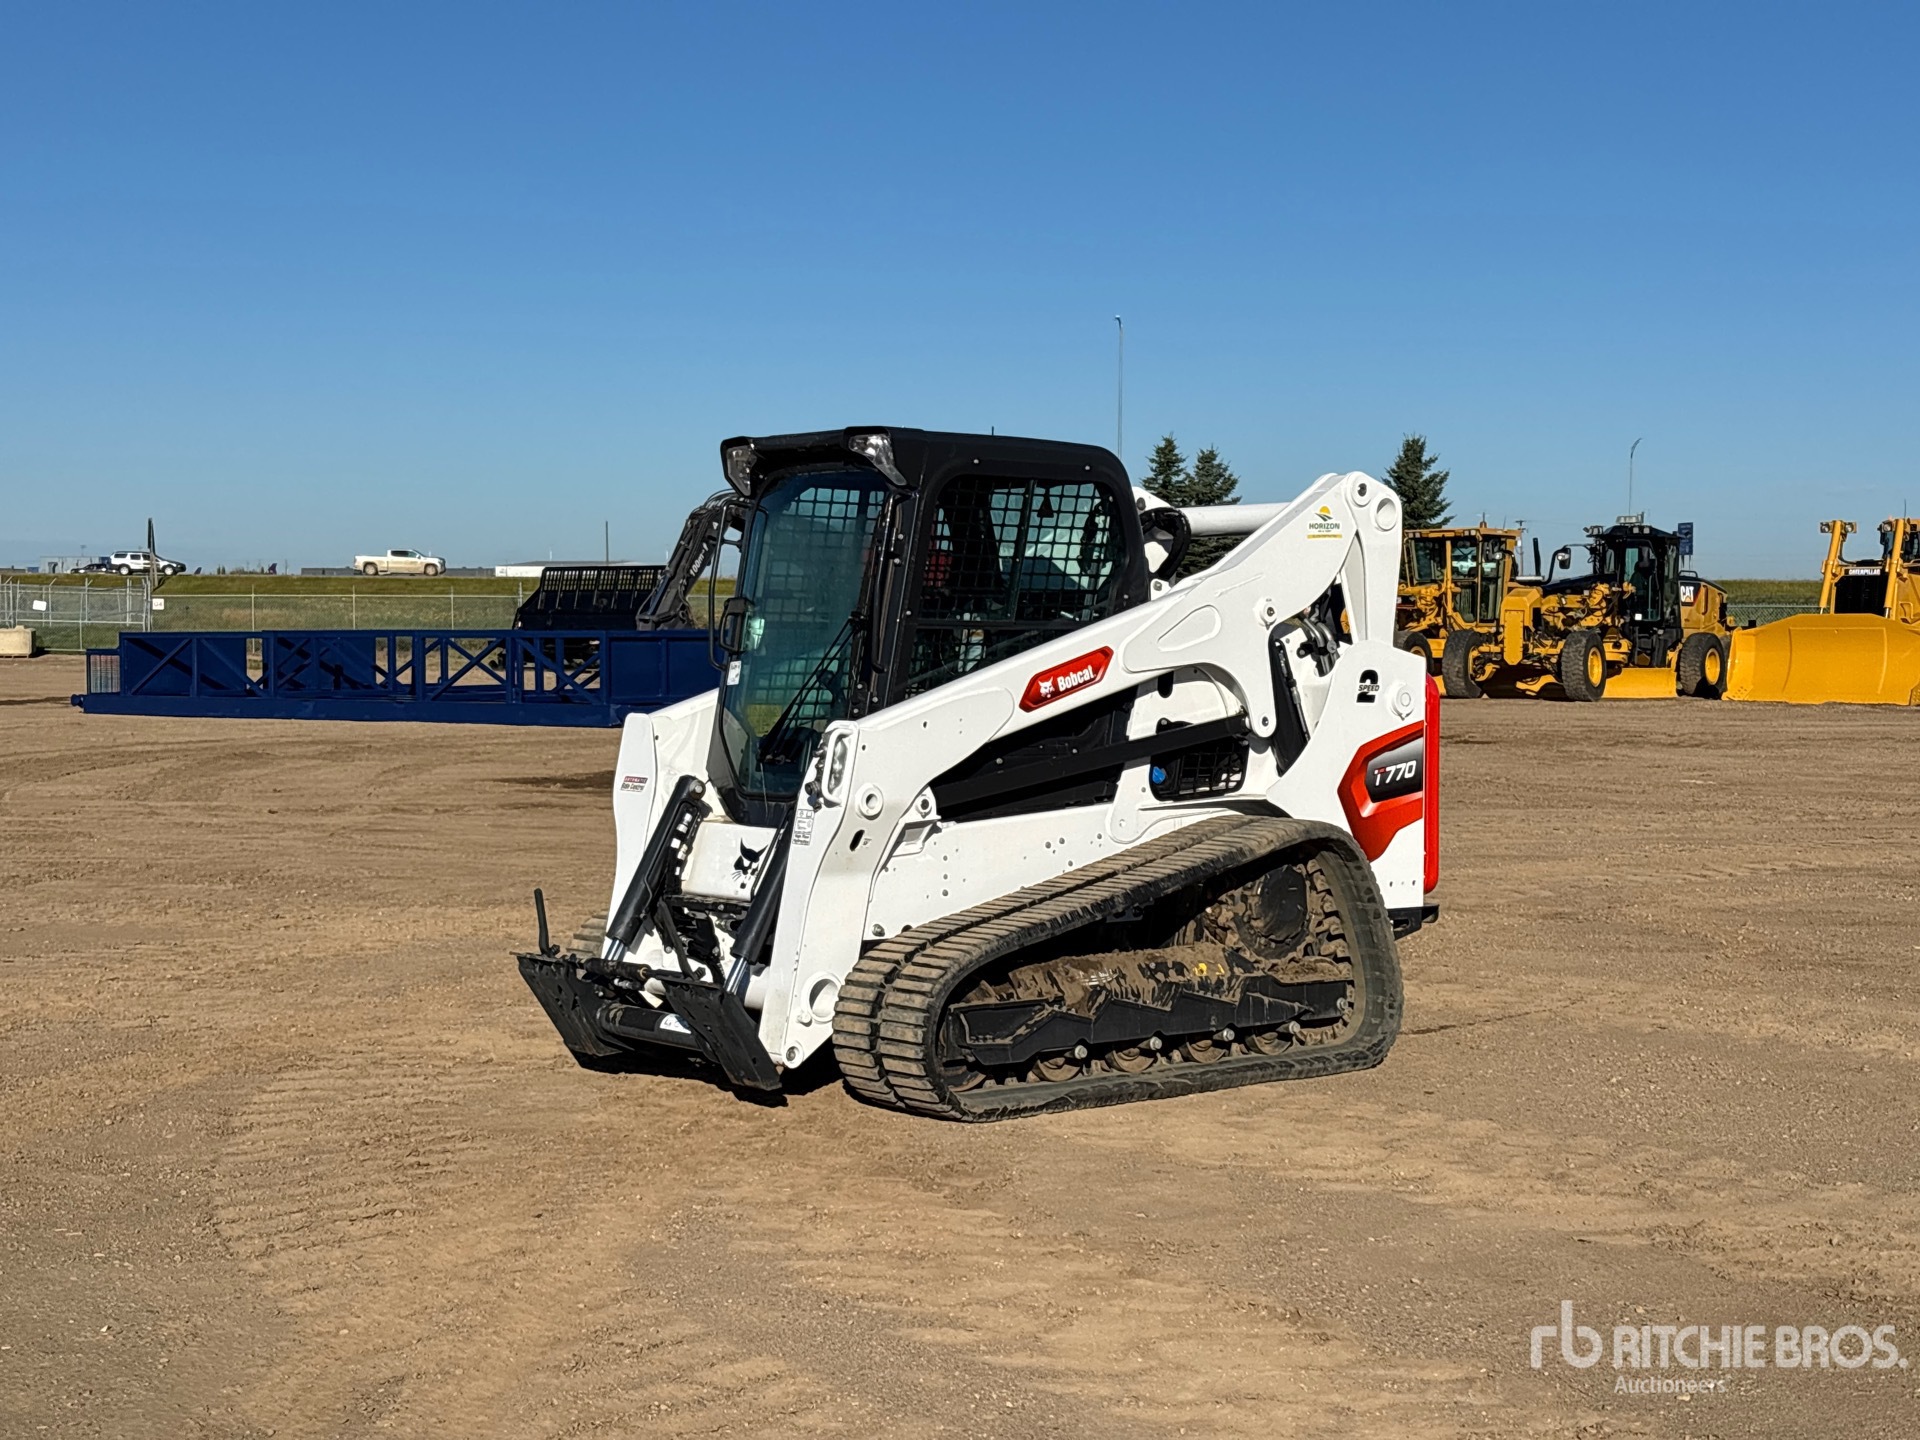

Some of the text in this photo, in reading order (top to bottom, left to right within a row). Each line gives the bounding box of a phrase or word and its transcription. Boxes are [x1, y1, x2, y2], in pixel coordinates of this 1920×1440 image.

[1308, 522, 1341, 530] HORIZON
[1848, 568, 1881, 576] CATERPILLAR
[1680, 585, 1695, 603] CAT
[1056, 664, 1095, 692] Bobcat
[1356, 669, 1379, 704] 2
[1358, 684, 1380, 692] SPEED
[1374, 760, 1417, 786] T770
